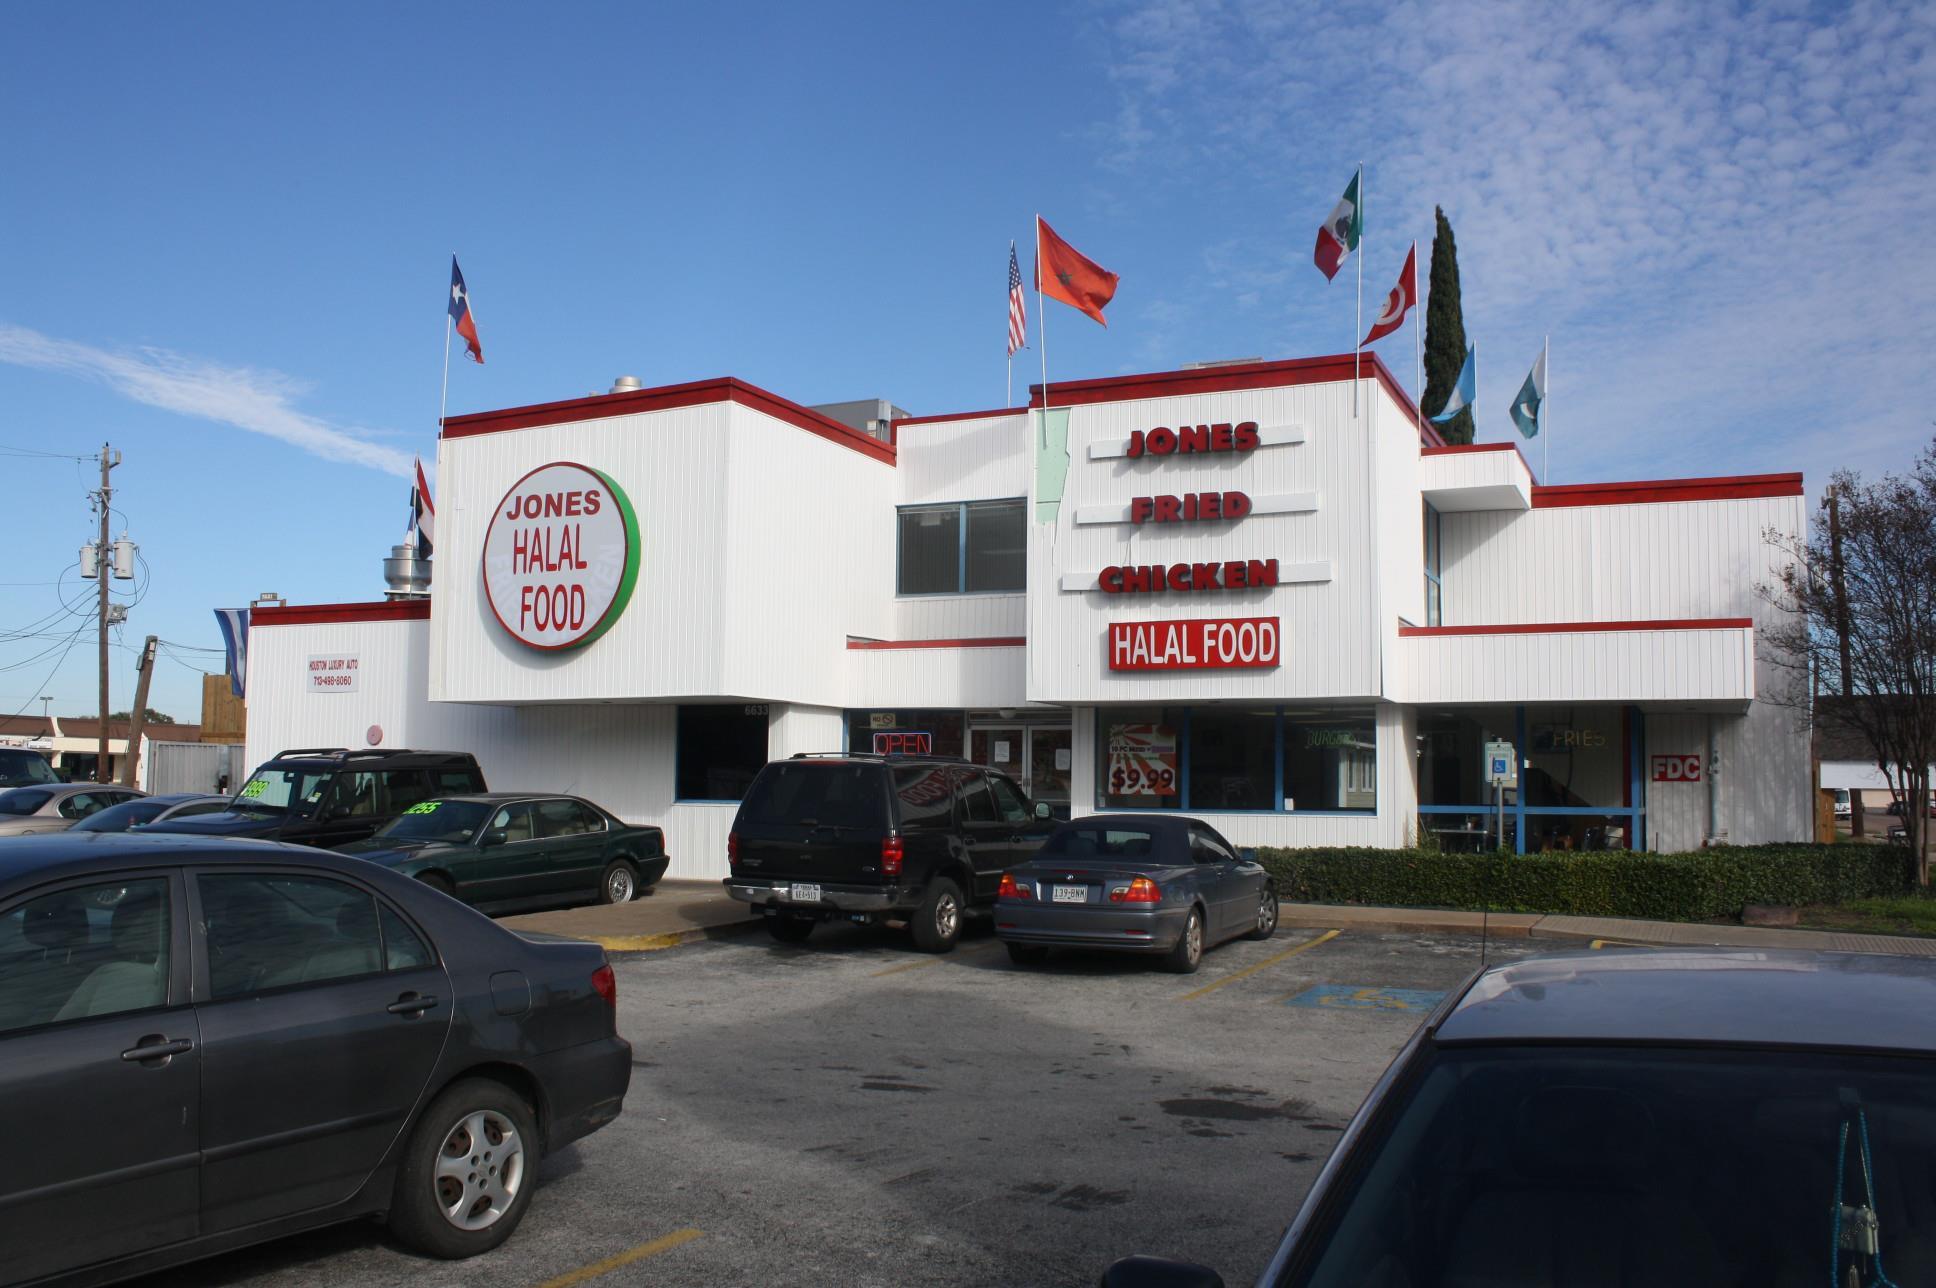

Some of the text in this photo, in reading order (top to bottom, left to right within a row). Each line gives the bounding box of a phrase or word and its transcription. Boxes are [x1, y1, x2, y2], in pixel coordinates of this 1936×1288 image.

[1127, 422, 1260, 459] JONES
[506, 490, 601, 520] JONES
[1131, 491, 1252, 524] FRIED
[513, 523, 587, 575] HALAL
[1098, 559, 1279, 593] CHICKEN
[520, 584, 585, 632] FOOD
[1115, 622, 1276, 665] HALAL FOOD
[309, 660, 327, 671] HOUSTON
[347, 659, 358, 669] AUTO
[877, 734, 929, 755] OPEN
[1112, 767, 1173, 788] $9.99
[1654, 757, 1700, 779] FDC
